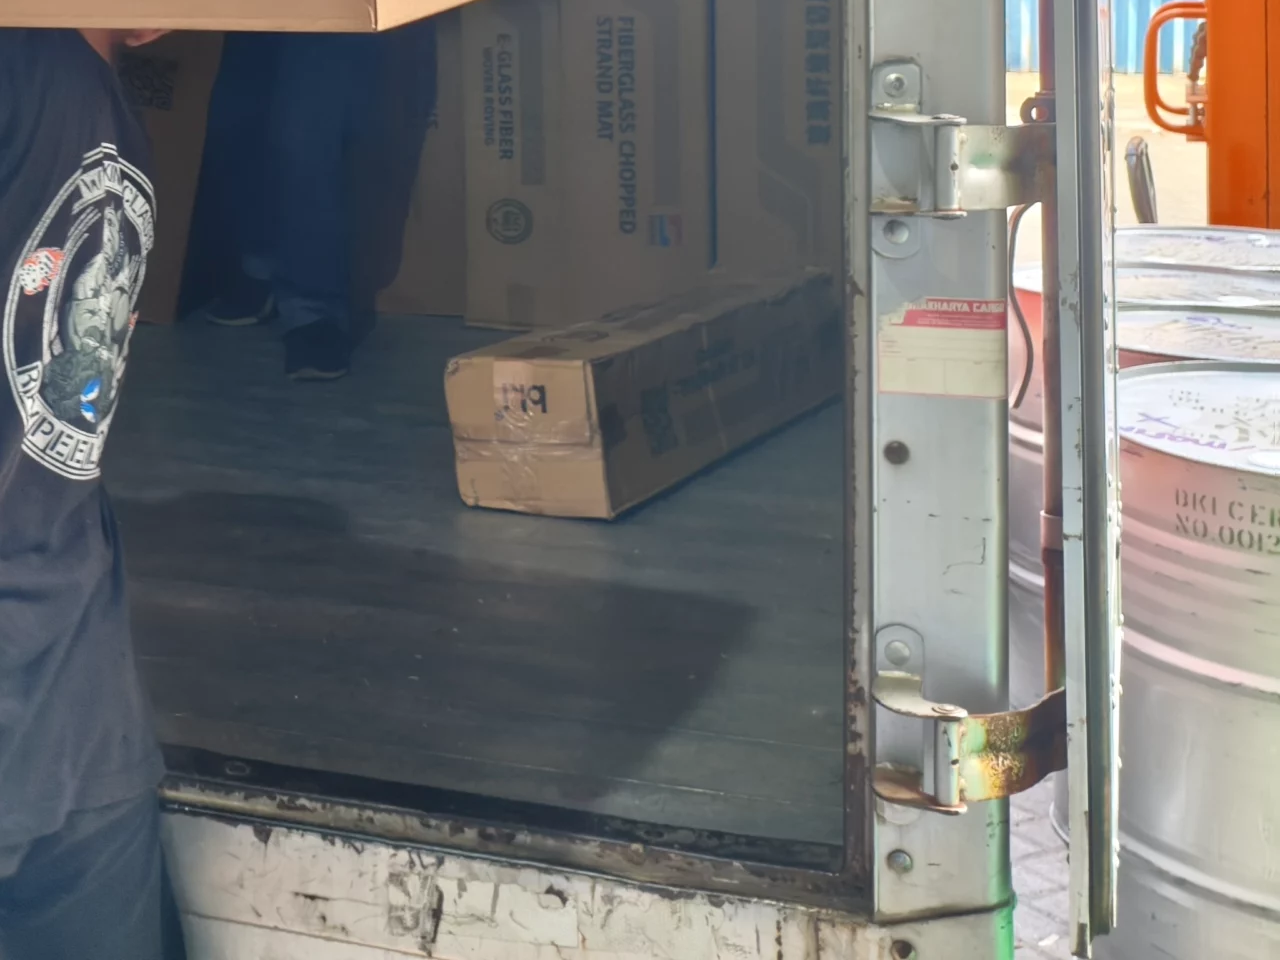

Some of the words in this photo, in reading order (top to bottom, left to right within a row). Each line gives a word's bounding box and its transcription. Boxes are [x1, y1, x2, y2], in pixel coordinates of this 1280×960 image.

[497, 33, 514, 108] E-GLASS
[596, 15, 613, 95] STRAND
[617, 15, 636, 135] FIBERGLASS
[498, 109, 514, 161] FIBER
[596, 99, 614, 143] MAT
[618, 140, 637, 235] CHOPPED
[1175, 487, 1218, 516] BKI
